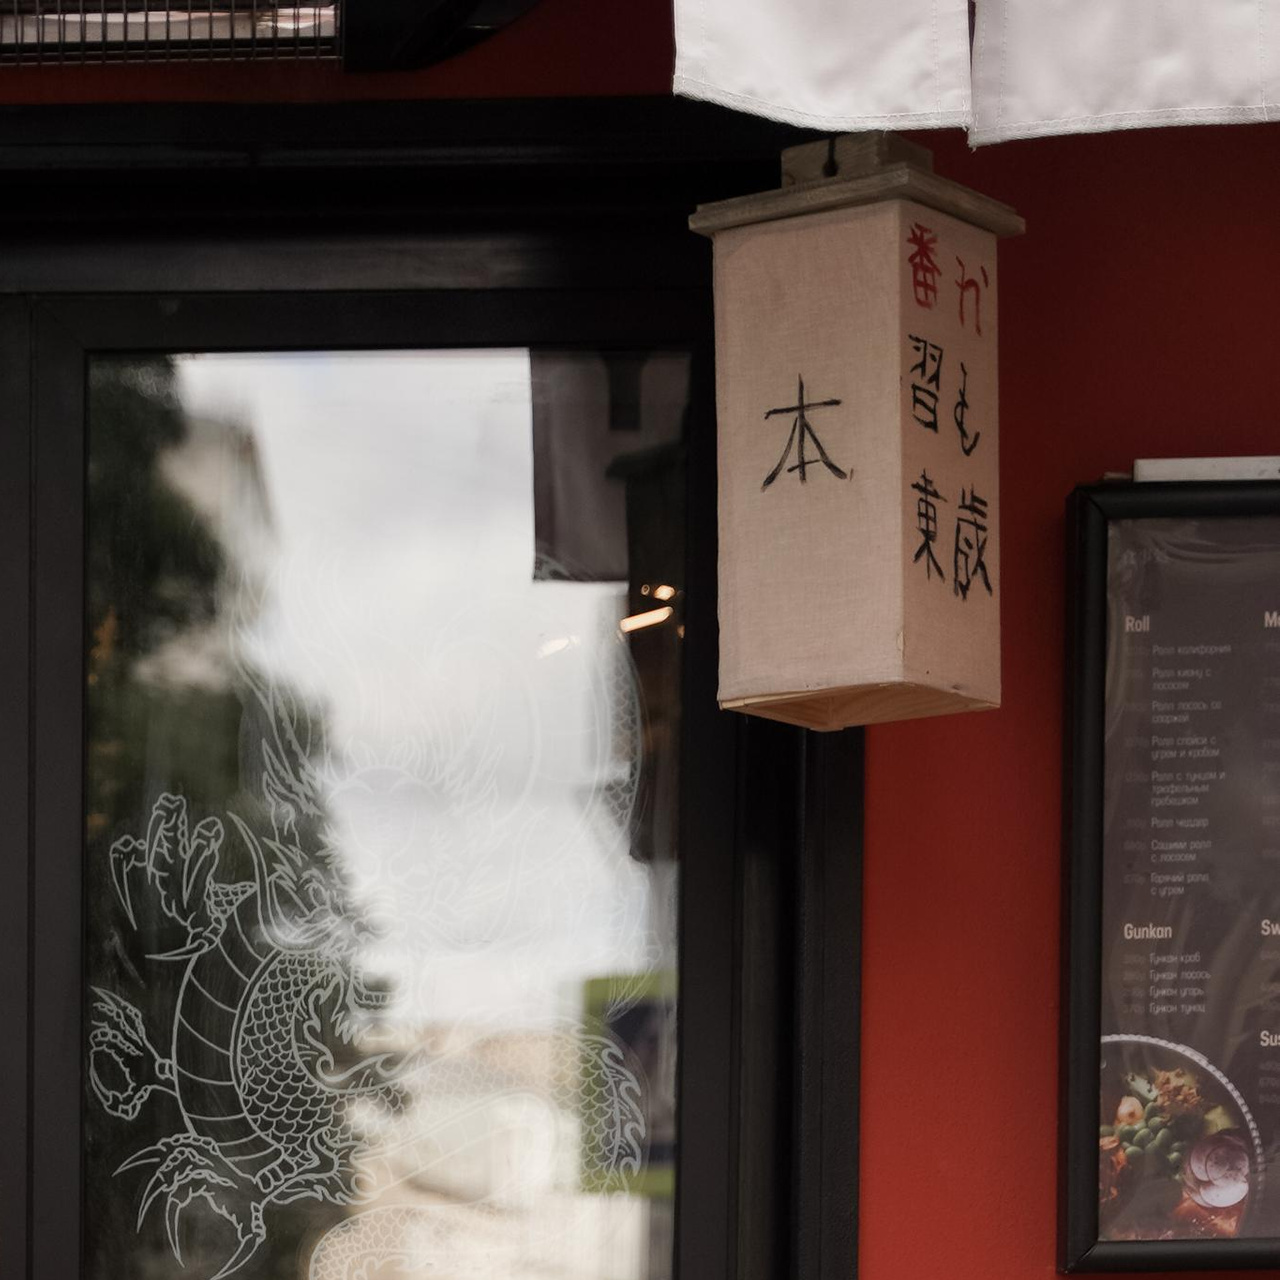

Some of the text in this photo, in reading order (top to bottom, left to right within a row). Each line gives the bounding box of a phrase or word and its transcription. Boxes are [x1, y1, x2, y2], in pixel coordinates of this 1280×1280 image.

[761, 373, 847, 492] 本
[1124, 615, 1151, 633] Roll
[1123, 922, 1173, 940] Gunkan
